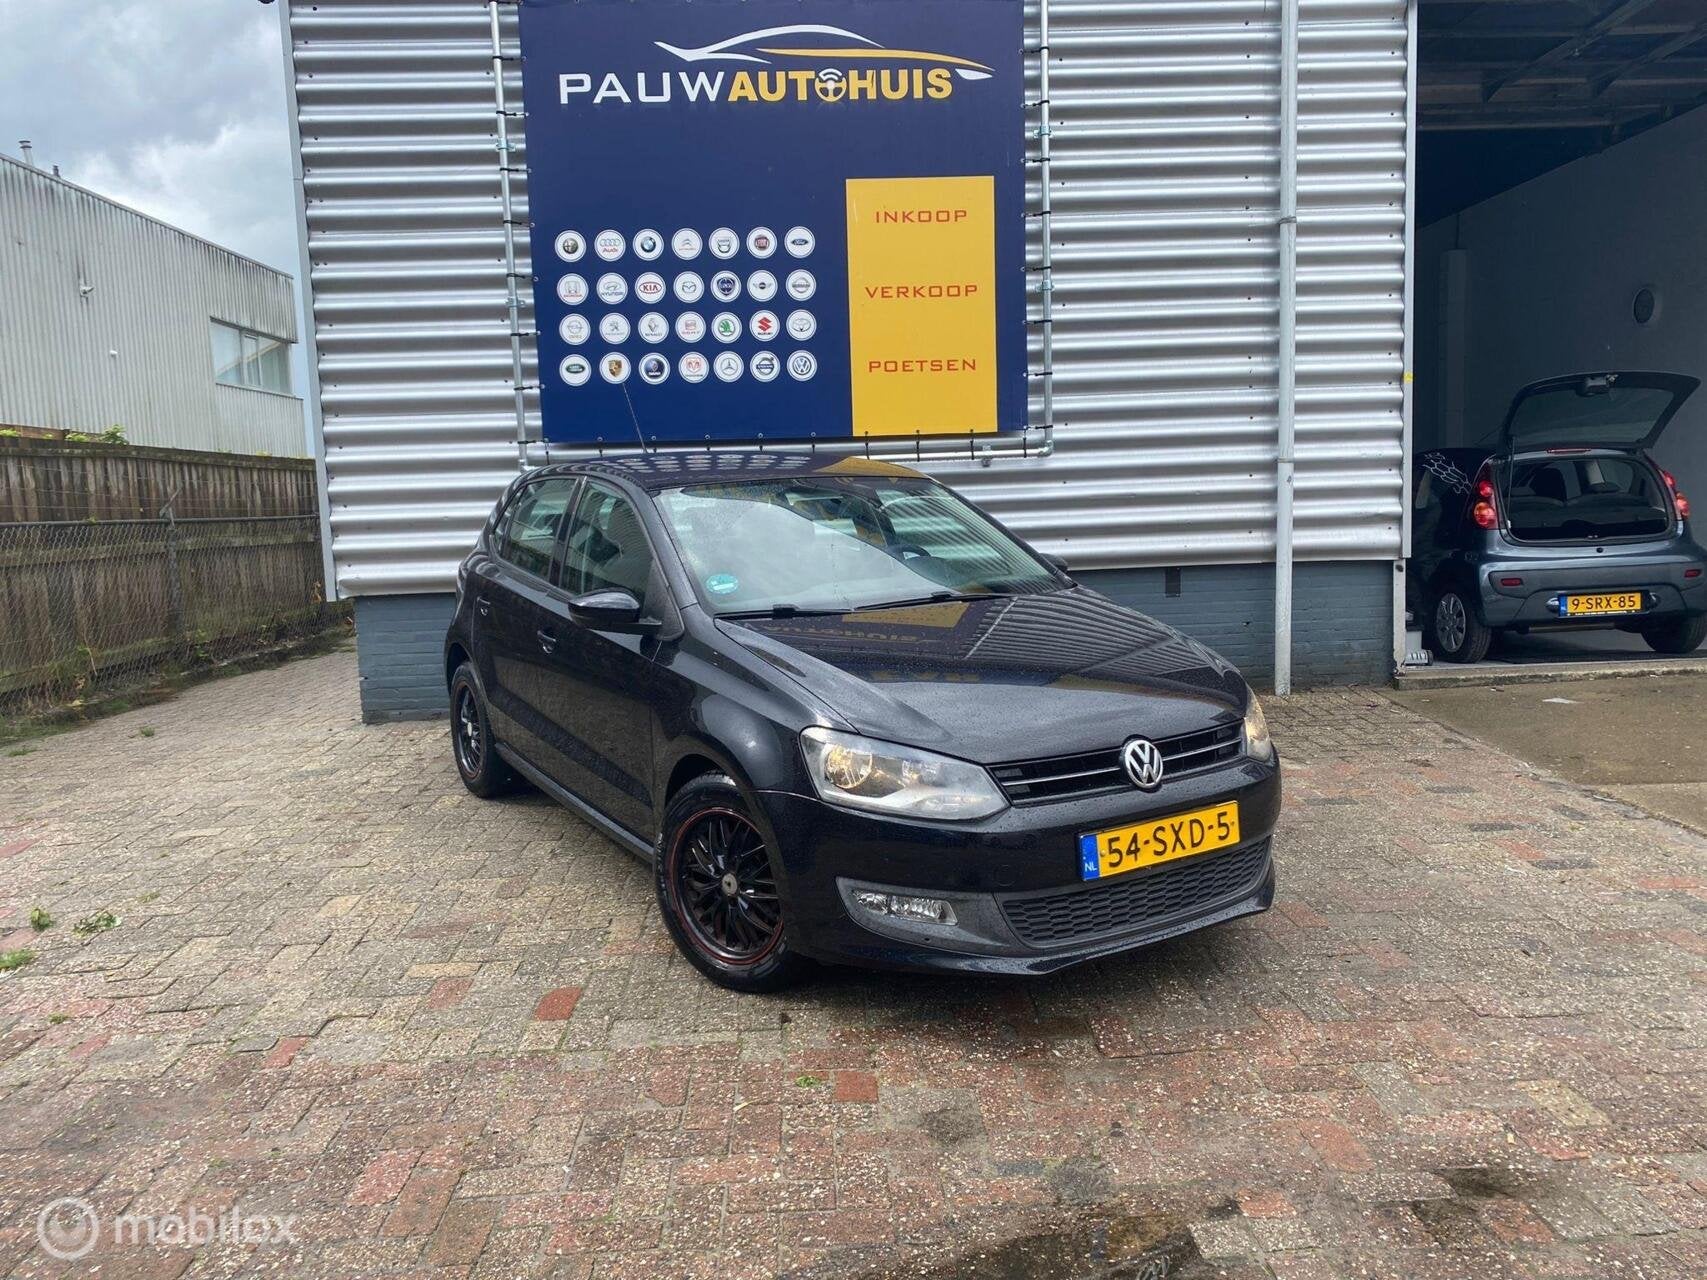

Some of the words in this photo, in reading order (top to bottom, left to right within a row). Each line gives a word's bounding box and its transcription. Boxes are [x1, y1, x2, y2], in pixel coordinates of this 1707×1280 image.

[875, 210, 967, 224] INKOOP
[864, 284, 978, 299] VERKOOP
[868, 359, 977, 373] POETSEN
[1571, 595, 1636, 611] 9-SRX-85
[1107, 811, 1230, 868] 54-SXD-5
[1084, 863, 1098, 872] NL
